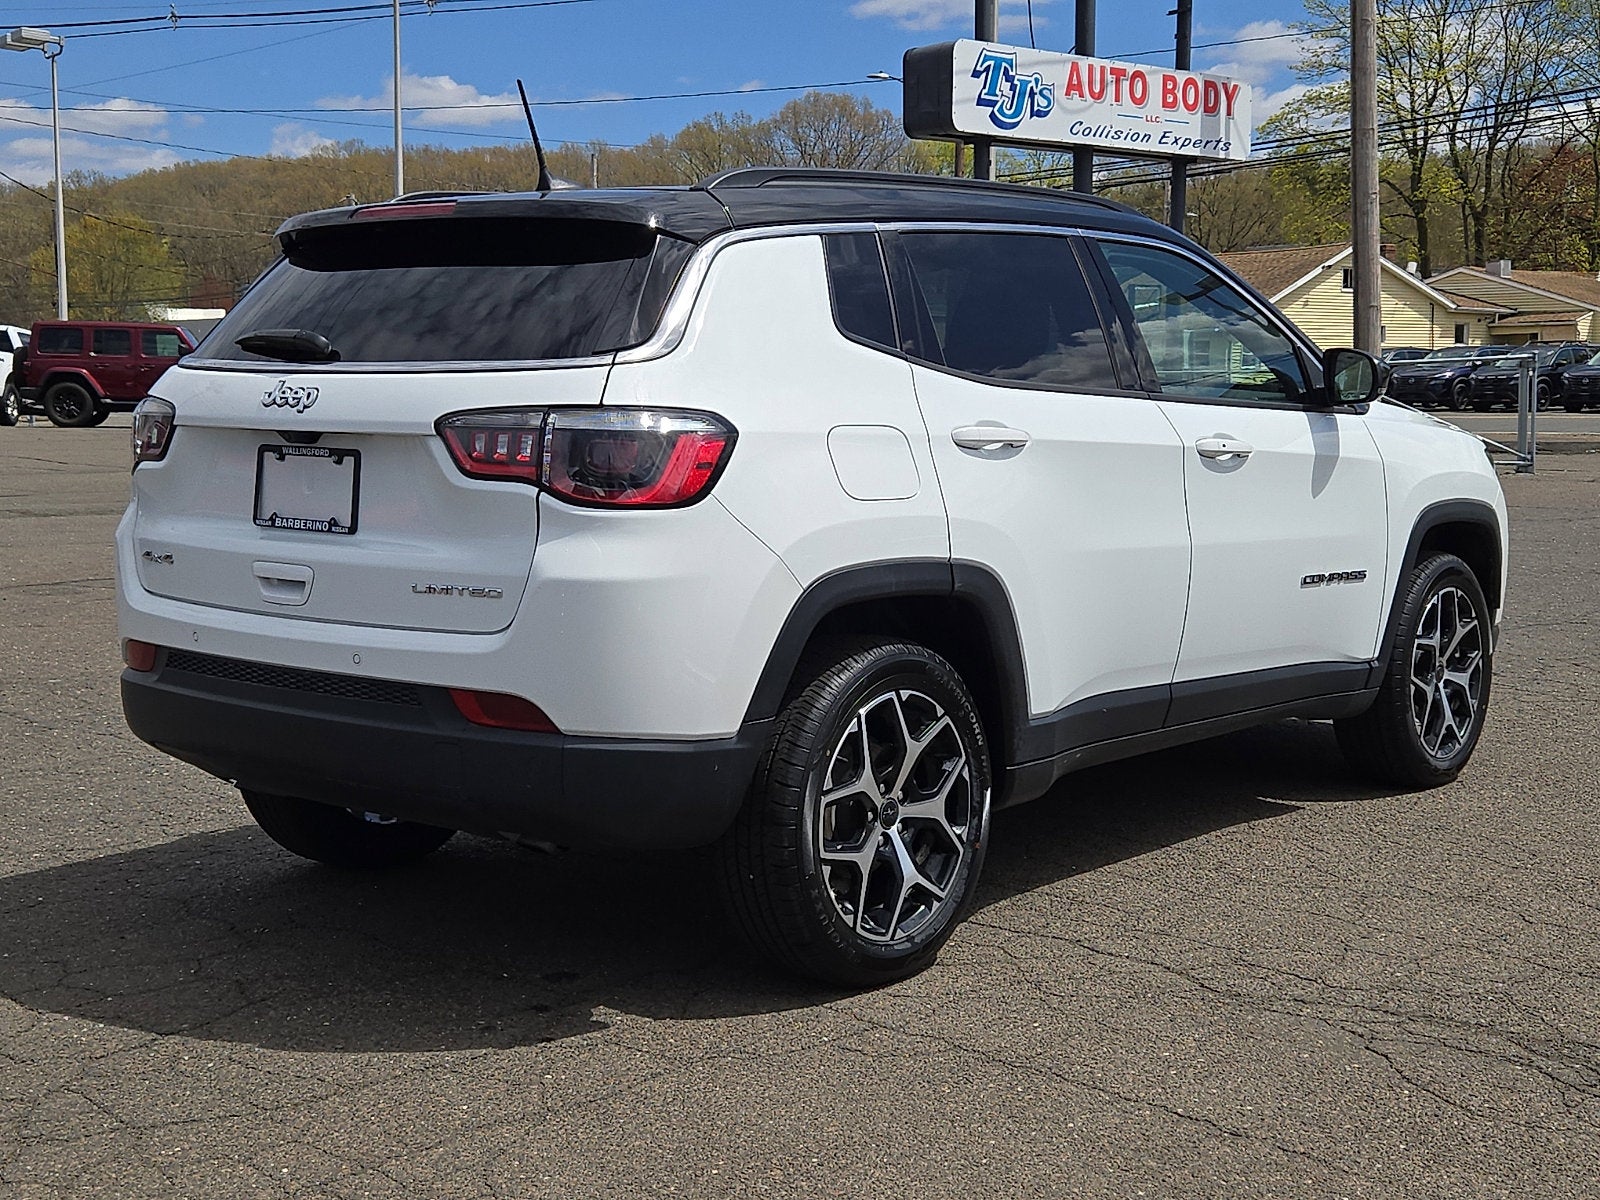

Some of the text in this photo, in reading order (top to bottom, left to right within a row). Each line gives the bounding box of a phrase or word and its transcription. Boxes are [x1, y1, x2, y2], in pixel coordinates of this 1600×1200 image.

[970, 47, 1239, 131] TJ's AUTO BODY
[1145, 115, 1163, 124] LLC.
[1069, 120, 1232, 152] Collision Experts
[261, 380, 320, 413] Jeep
[282, 446, 330, 456] WALLINGFORD
[275, 517, 329, 531] BARBERINO
[1300, 570, 1367, 588] COMPASS
[411, 583, 503, 599] LIMITED
